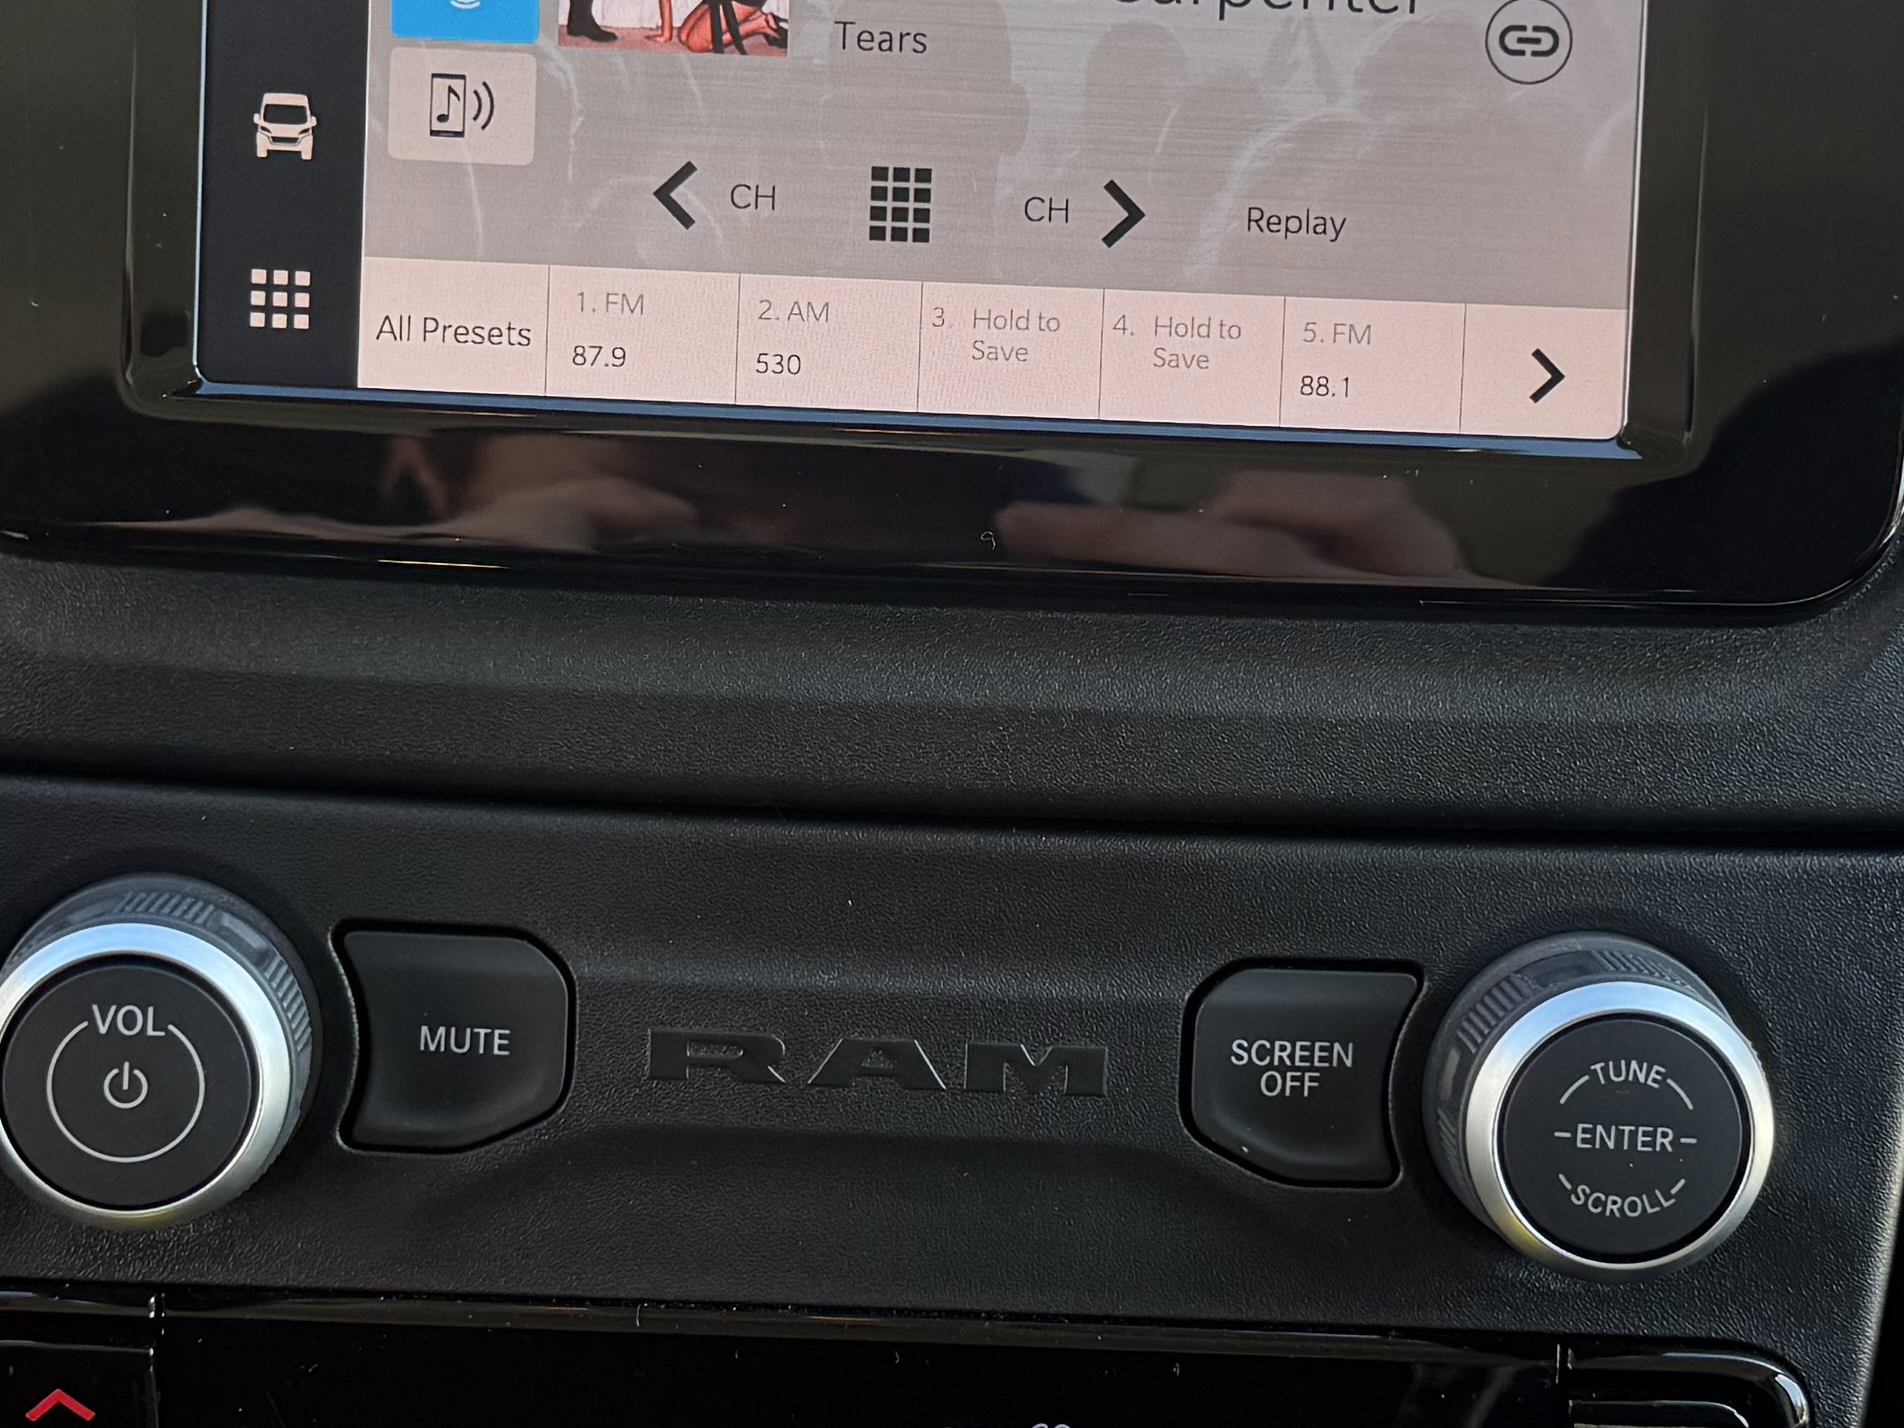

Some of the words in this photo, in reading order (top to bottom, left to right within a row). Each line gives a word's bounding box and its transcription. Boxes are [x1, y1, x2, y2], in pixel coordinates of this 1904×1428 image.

[833, 22, 928, 54] Tears
[730, 183, 776, 212] CH
[1024, 196, 1069, 224] CH
[1246, 207, 1346, 242] Replay
[577, 291, 595, 313] 1.
[605, 293, 644, 315] FM
[758, 299, 779, 321] 2.
[787, 301, 830, 323] AM
[375, 316, 411, 342] All
[422, 317, 531, 346] Presets
[972, 308, 1030, 332] Hold
[1039, 312, 1061, 332] to
[1112, 314, 1134, 337] 4.
[1154, 315, 1211, 340] Hold
[1219, 319, 1241, 340] to
[1302, 322, 1325, 343] 5.
[1333, 323, 1372, 346] FM
[572, 346, 626, 368] 87.9
[754, 353, 801, 376] 530
[971, 340, 1029, 362] Save
[1153, 348, 1210, 370] Save
[1300, 376, 1351, 398] 88.1
[92, 1005, 165, 1037] VOL
[419, 1025, 510, 1057] MUTE
[1230, 1039, 1354, 1068] SCREEN
[646, 1028, 1108, 1097] RAM
[1591, 1059, 1667, 1090] TUNE
[1260, 1071, 1320, 1098] OFF
[1576, 1124, 1673, 1152] ENTER
[1570, 1183, 1675, 1218] SCROLL
